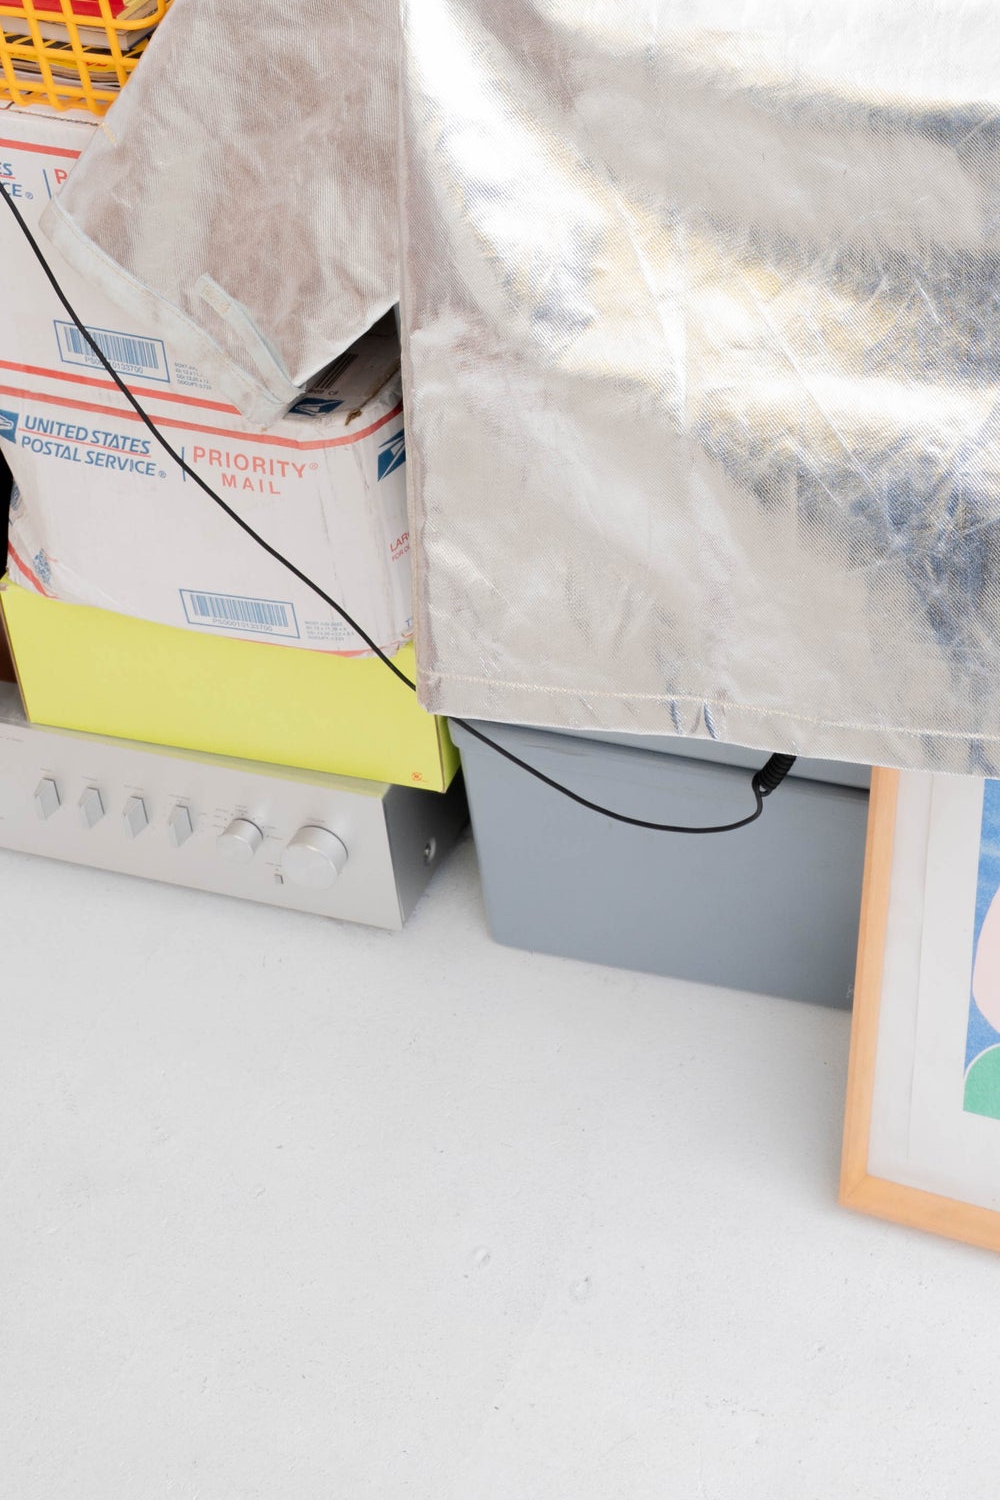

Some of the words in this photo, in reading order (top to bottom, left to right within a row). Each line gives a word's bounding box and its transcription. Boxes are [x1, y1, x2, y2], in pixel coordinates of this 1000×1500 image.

[24, 415, 88, 441] UNITED
[90, 430, 151, 454] STATES
[22, 436, 81, 462] POSTAL
[222, 473, 281, 495] MAIL
